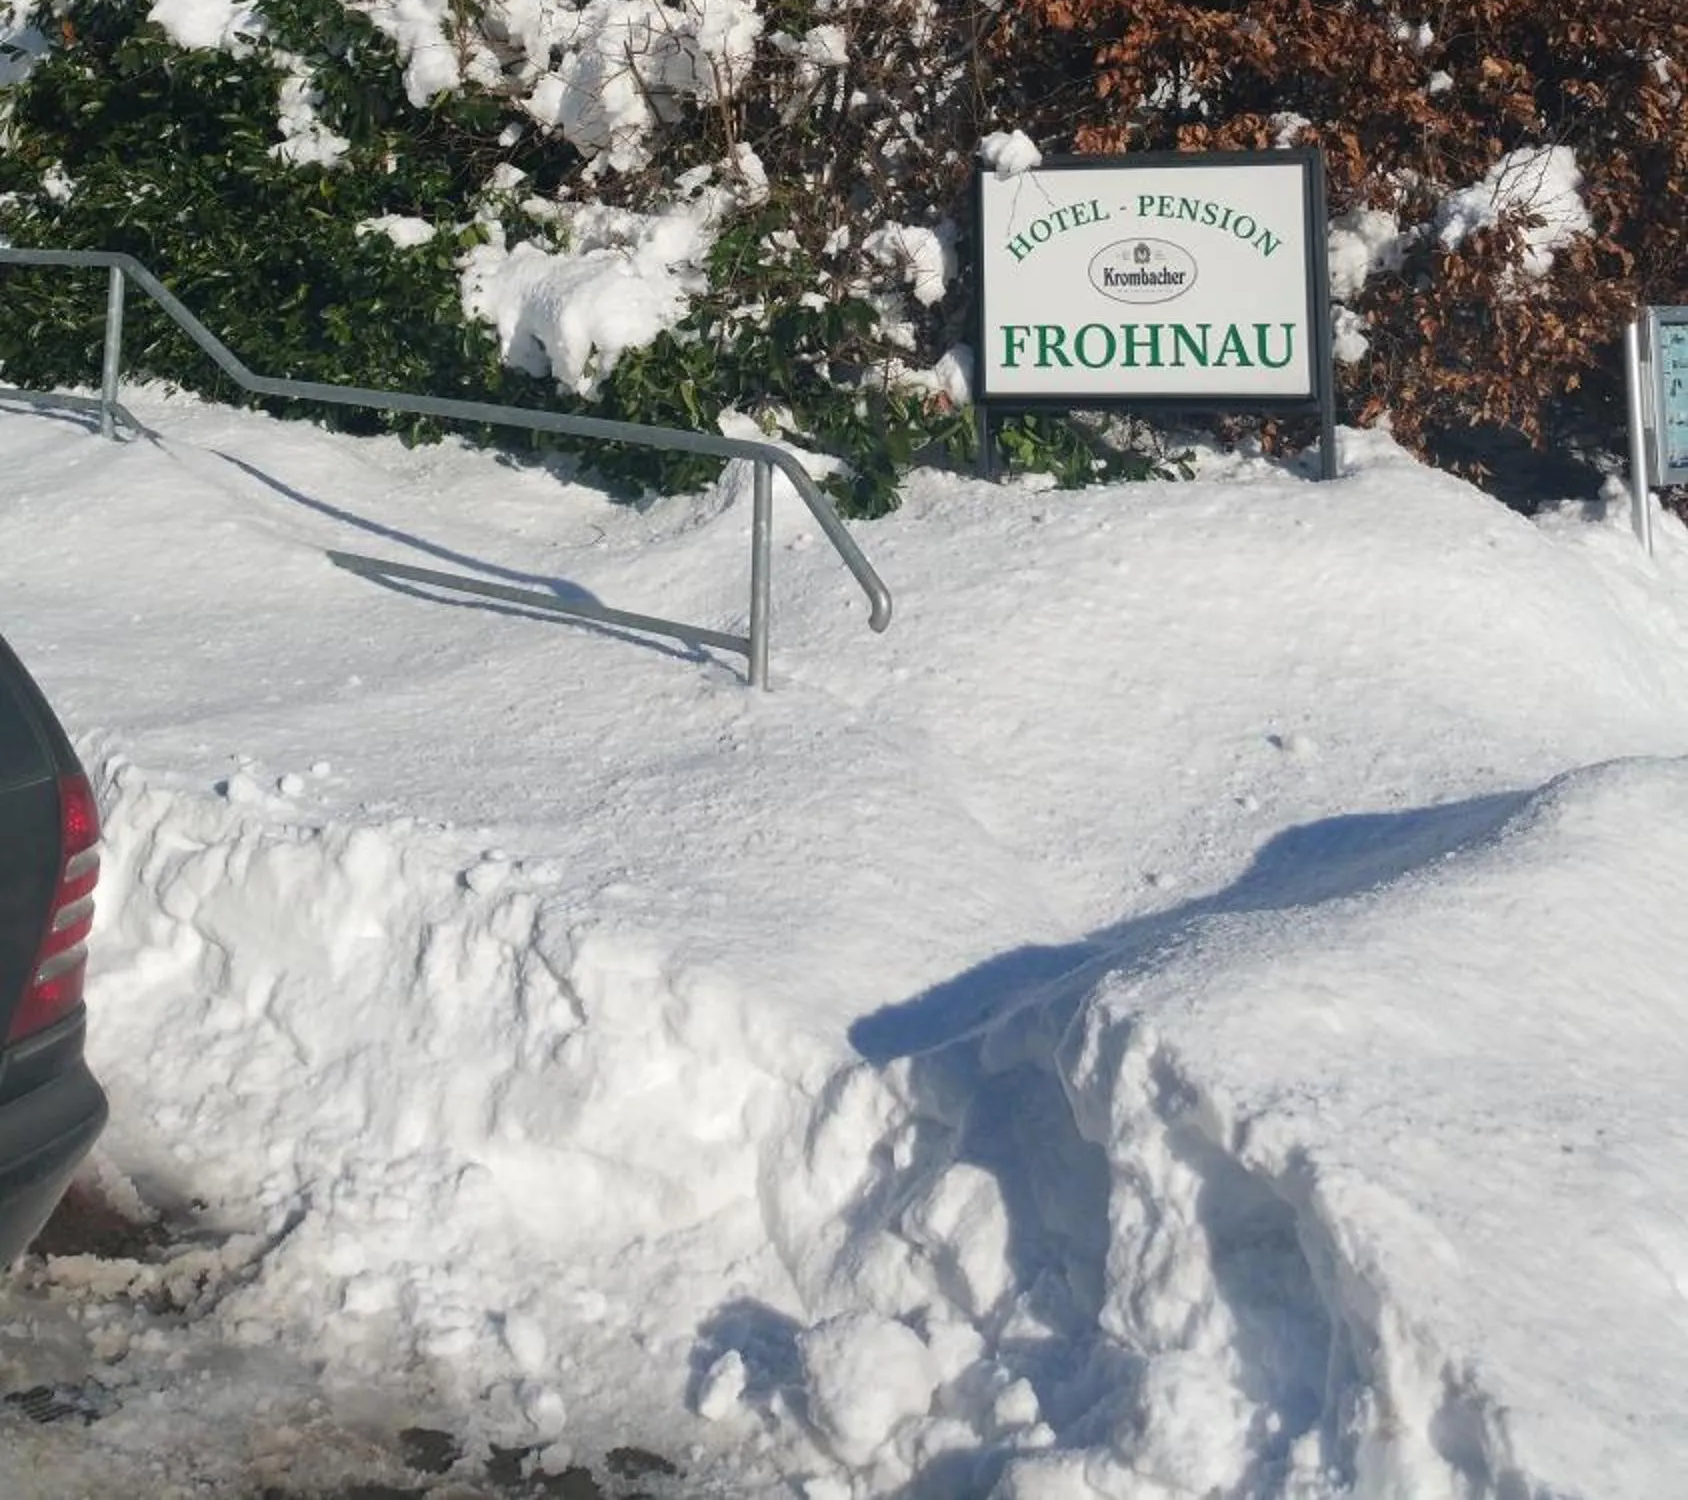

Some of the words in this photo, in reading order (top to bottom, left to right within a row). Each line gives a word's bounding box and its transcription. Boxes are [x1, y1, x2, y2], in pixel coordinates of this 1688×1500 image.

[1005, 199, 1111, 262] HOTEL
[1136, 195, 1282, 258] PENSION
[1103, 265, 1186, 286] Krombacher
[999, 323, 1296, 368] FROHNAU
